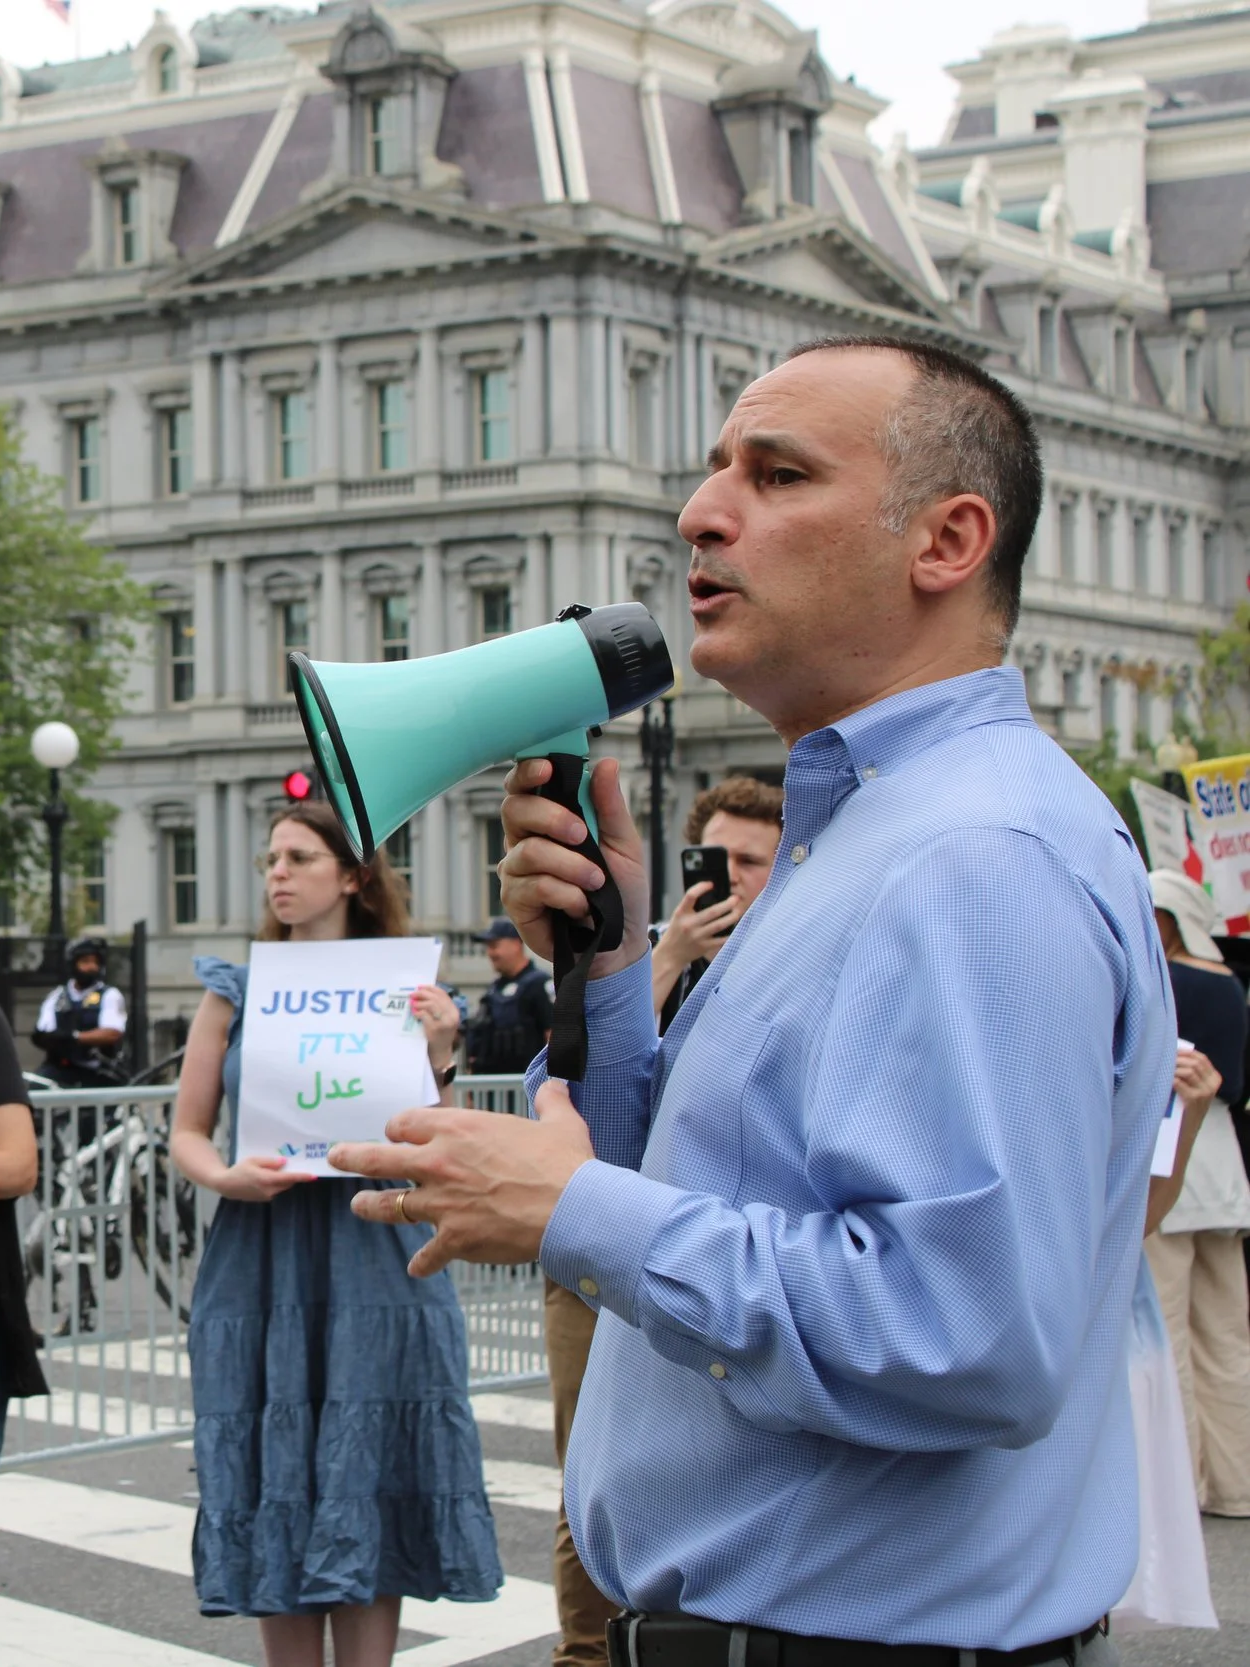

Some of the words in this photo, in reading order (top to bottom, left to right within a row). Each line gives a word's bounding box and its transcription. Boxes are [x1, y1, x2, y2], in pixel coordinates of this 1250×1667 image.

[260, 987, 416, 1015] JUSTIC
[298, 1032, 370, 1064] צדק
[296, 1071, 364, 1110] عدل
